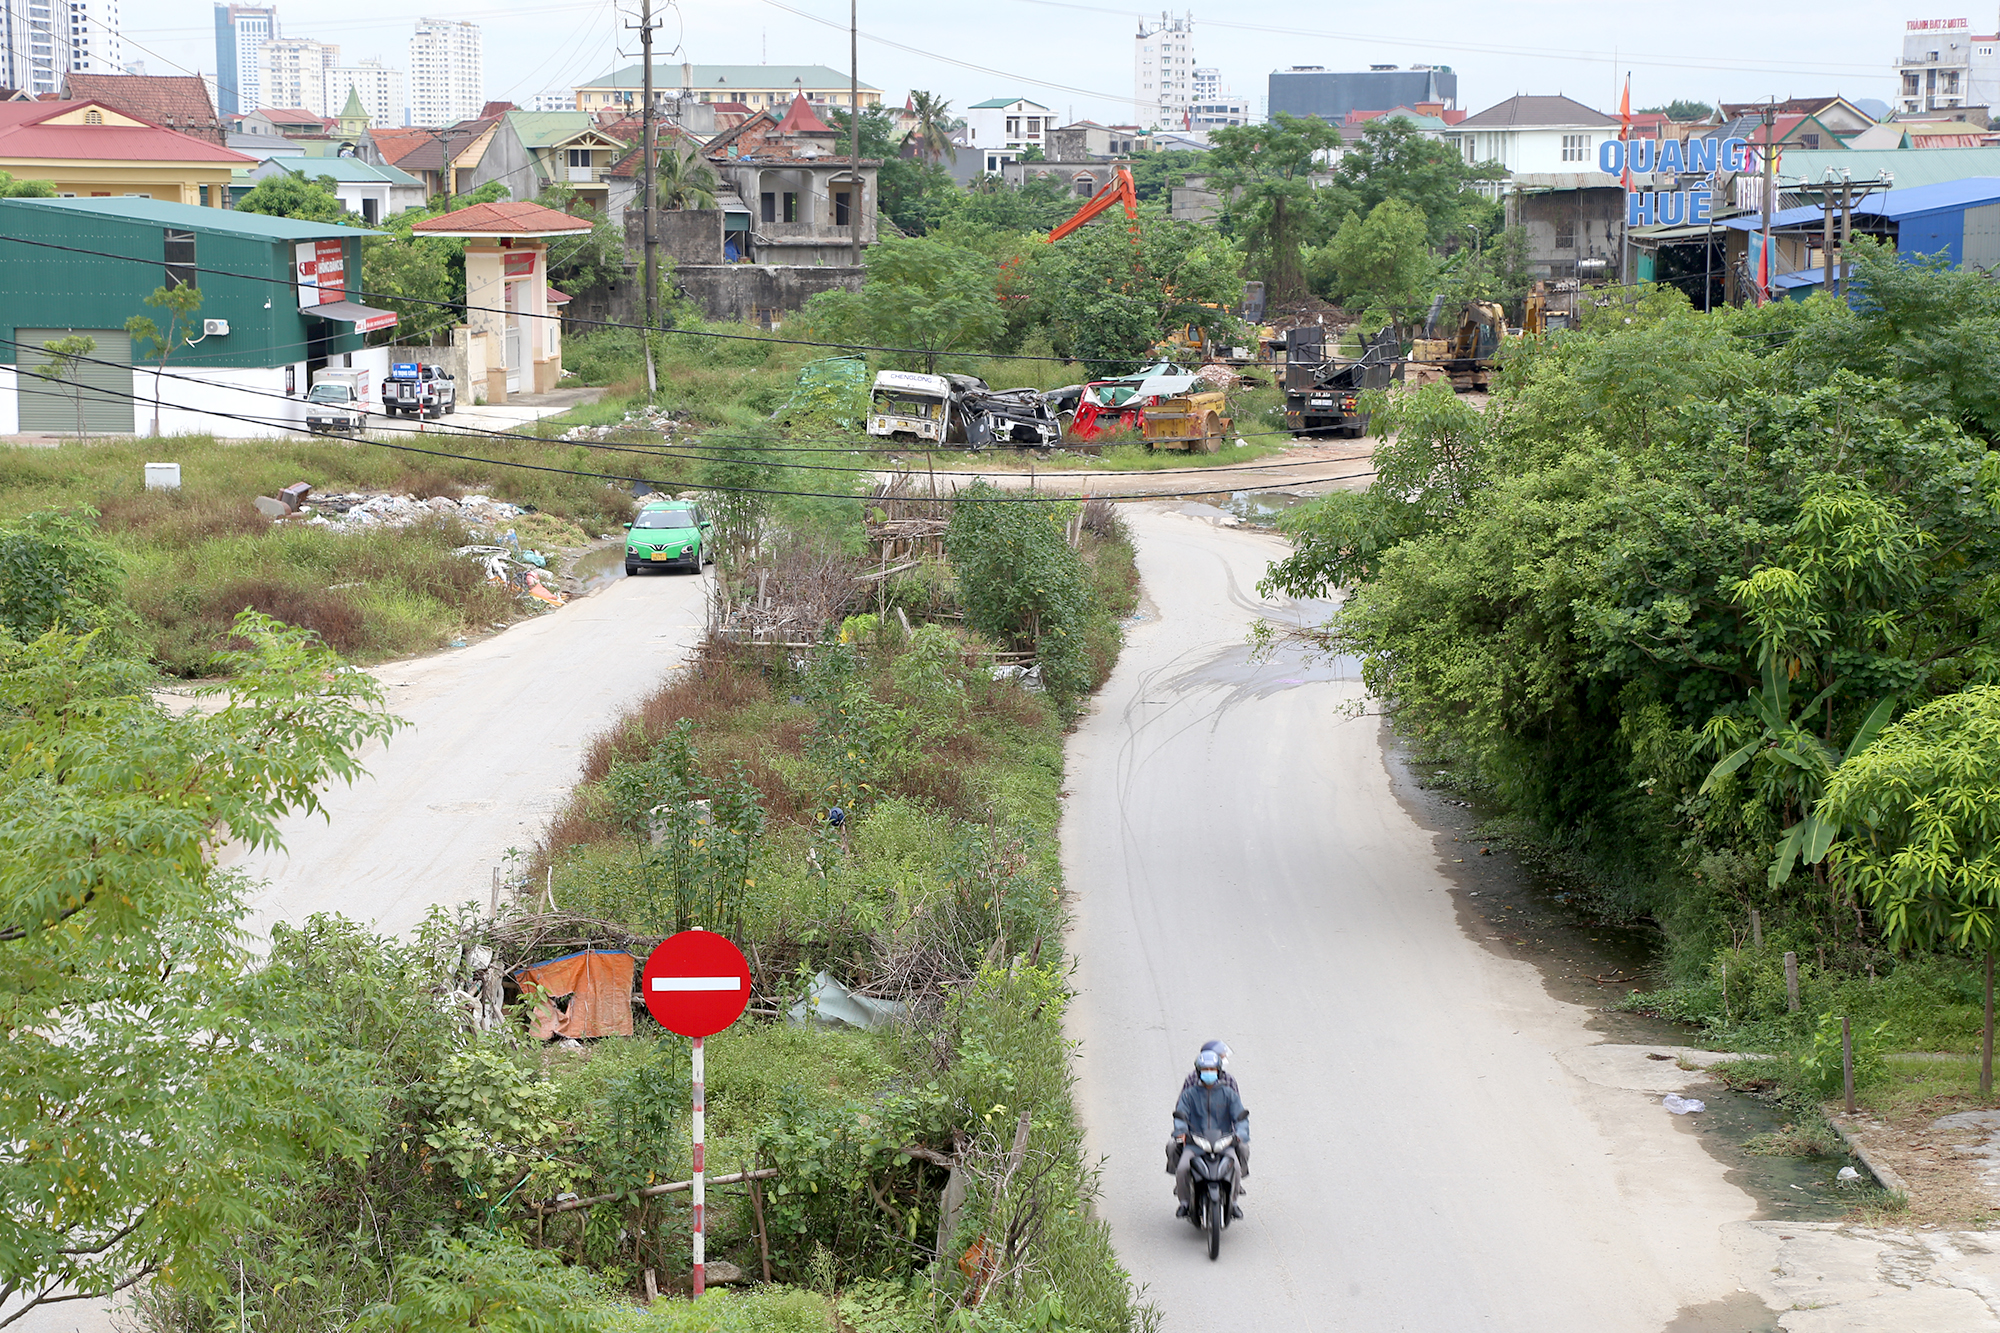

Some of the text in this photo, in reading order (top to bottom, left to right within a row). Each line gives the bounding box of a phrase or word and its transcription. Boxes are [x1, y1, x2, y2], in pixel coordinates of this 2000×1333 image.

[1942, 19, 1947, 29] 2
[1948, 18, 1969, 28] HOTEL
[1599, 137, 1748, 177] QUANG
[1627, 172, 1715, 226] HUẾ
[890, 373, 933, 383] CHENGLONG
